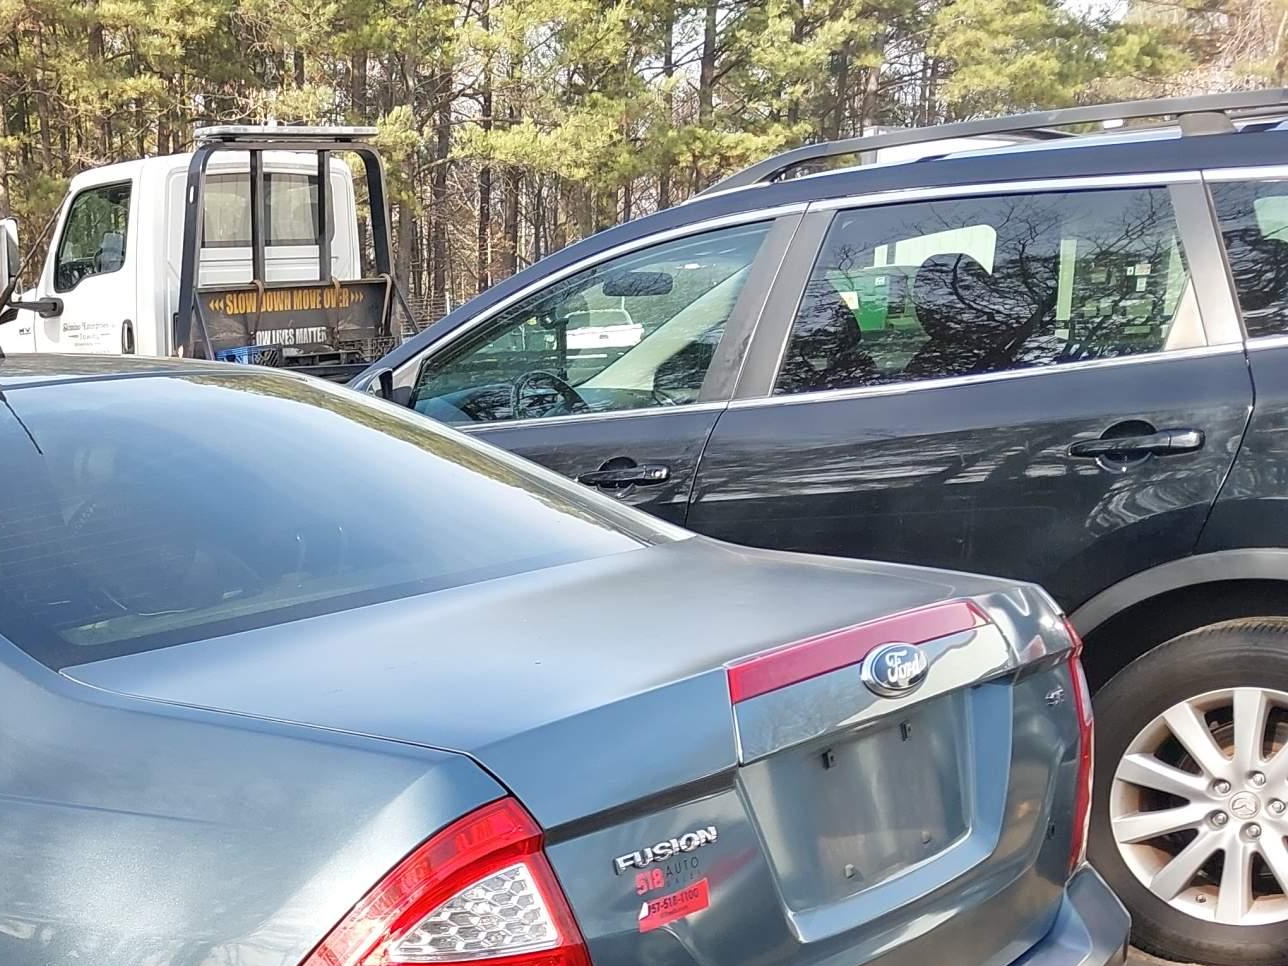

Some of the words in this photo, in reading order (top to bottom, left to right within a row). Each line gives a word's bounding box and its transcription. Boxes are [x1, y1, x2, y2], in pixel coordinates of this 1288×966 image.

[226, 292, 257, 315] SLOW
[293, 289, 322, 310] MOVE
[256, 330, 272, 346] OW
[272, 328, 295, 346] LIVES
[296, 326, 327, 345] MATTER
[885, 649, 923, 683] Ford
[614, 826, 718, 875] FUSION
[635, 868, 665, 896] 518
[665, 856, 699, 877] AUTO
